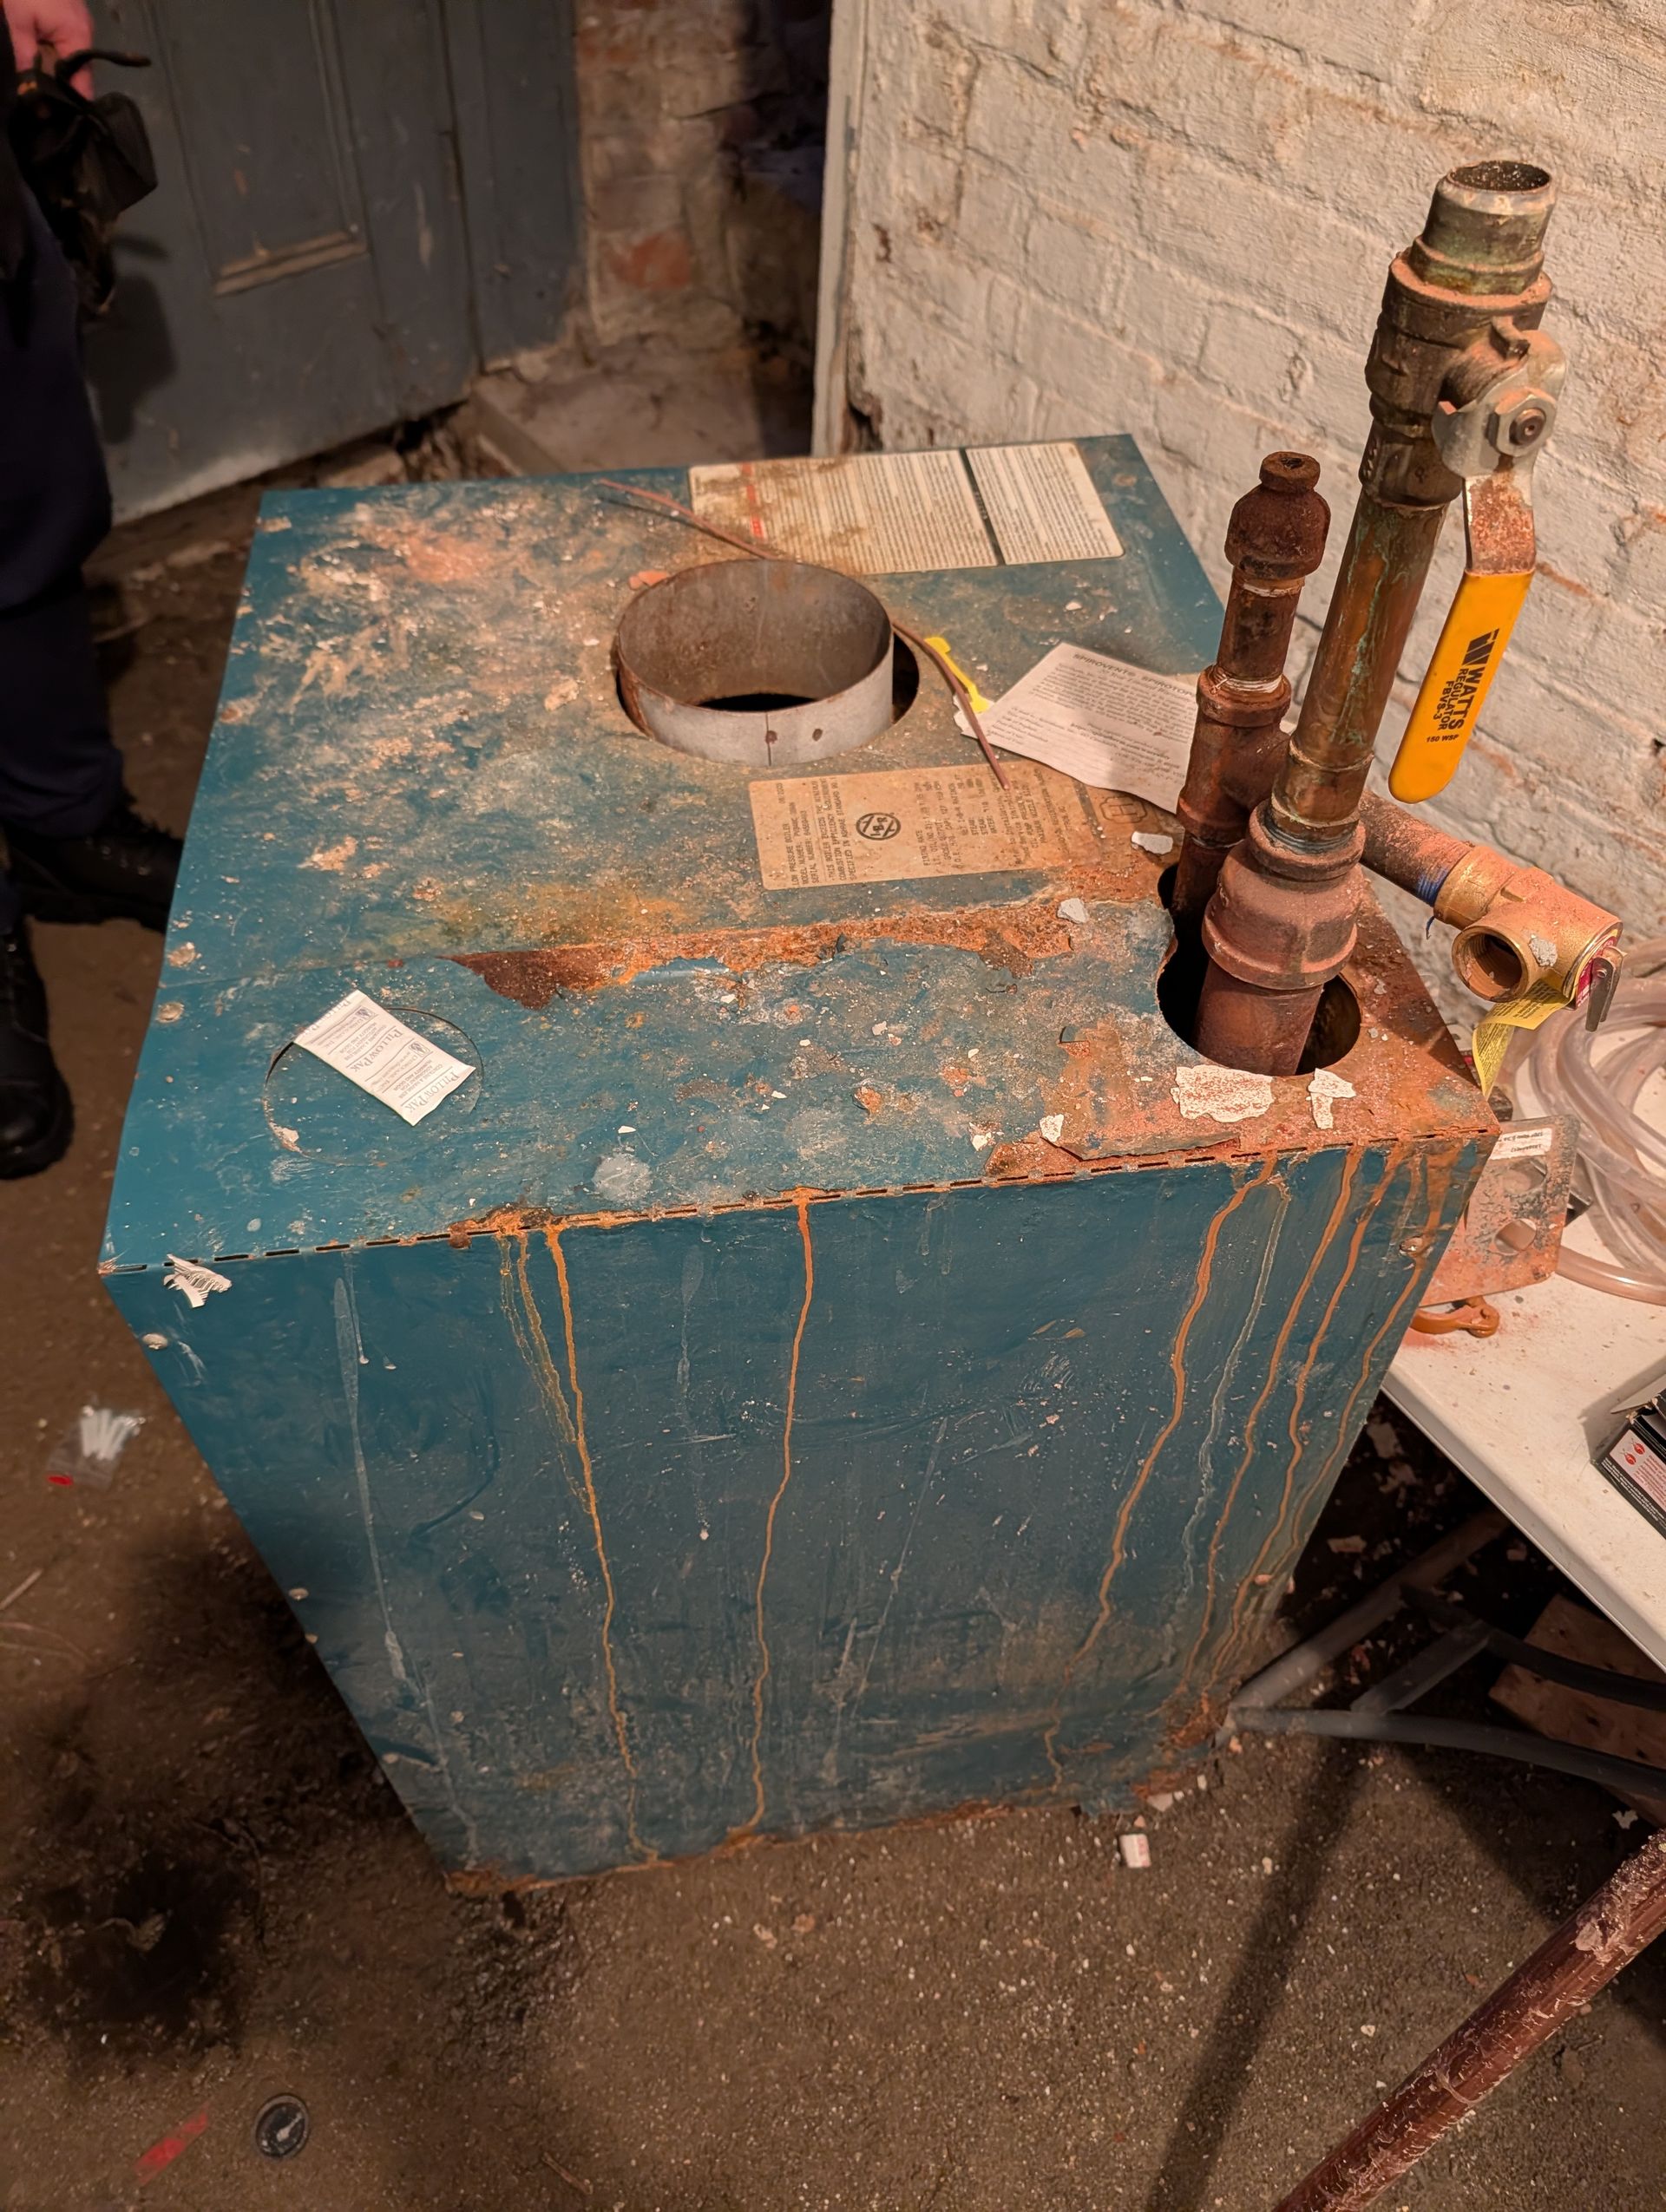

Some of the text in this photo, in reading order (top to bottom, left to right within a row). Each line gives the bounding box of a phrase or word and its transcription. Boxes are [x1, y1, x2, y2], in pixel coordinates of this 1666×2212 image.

[1433, 680, 1454, 720] FBVS-3
[1437, 668, 1468, 730] REGULATOR
[1447, 666, 1486, 730] WATTS
[833, 791, 844, 815] STANDARD
[783, 823, 792, 843] BOILER
[818, 817, 828, 839] EXCEEDS
[827, 813, 839, 845] EFFICIENCY
[839, 819, 848, 837] ASHRAE
[786, 845, 797, 871] PRESSURE
[823, 842, 833, 862] BOILER
[916, 830, 931, 865] FIRING RATE
[800, 867, 809, 884] MODEL
[810, 863, 819, 883] SERIAL
[834, 847, 847, 880] COMBUSTION
[845, 849, 857, 880] SPECIFIED
